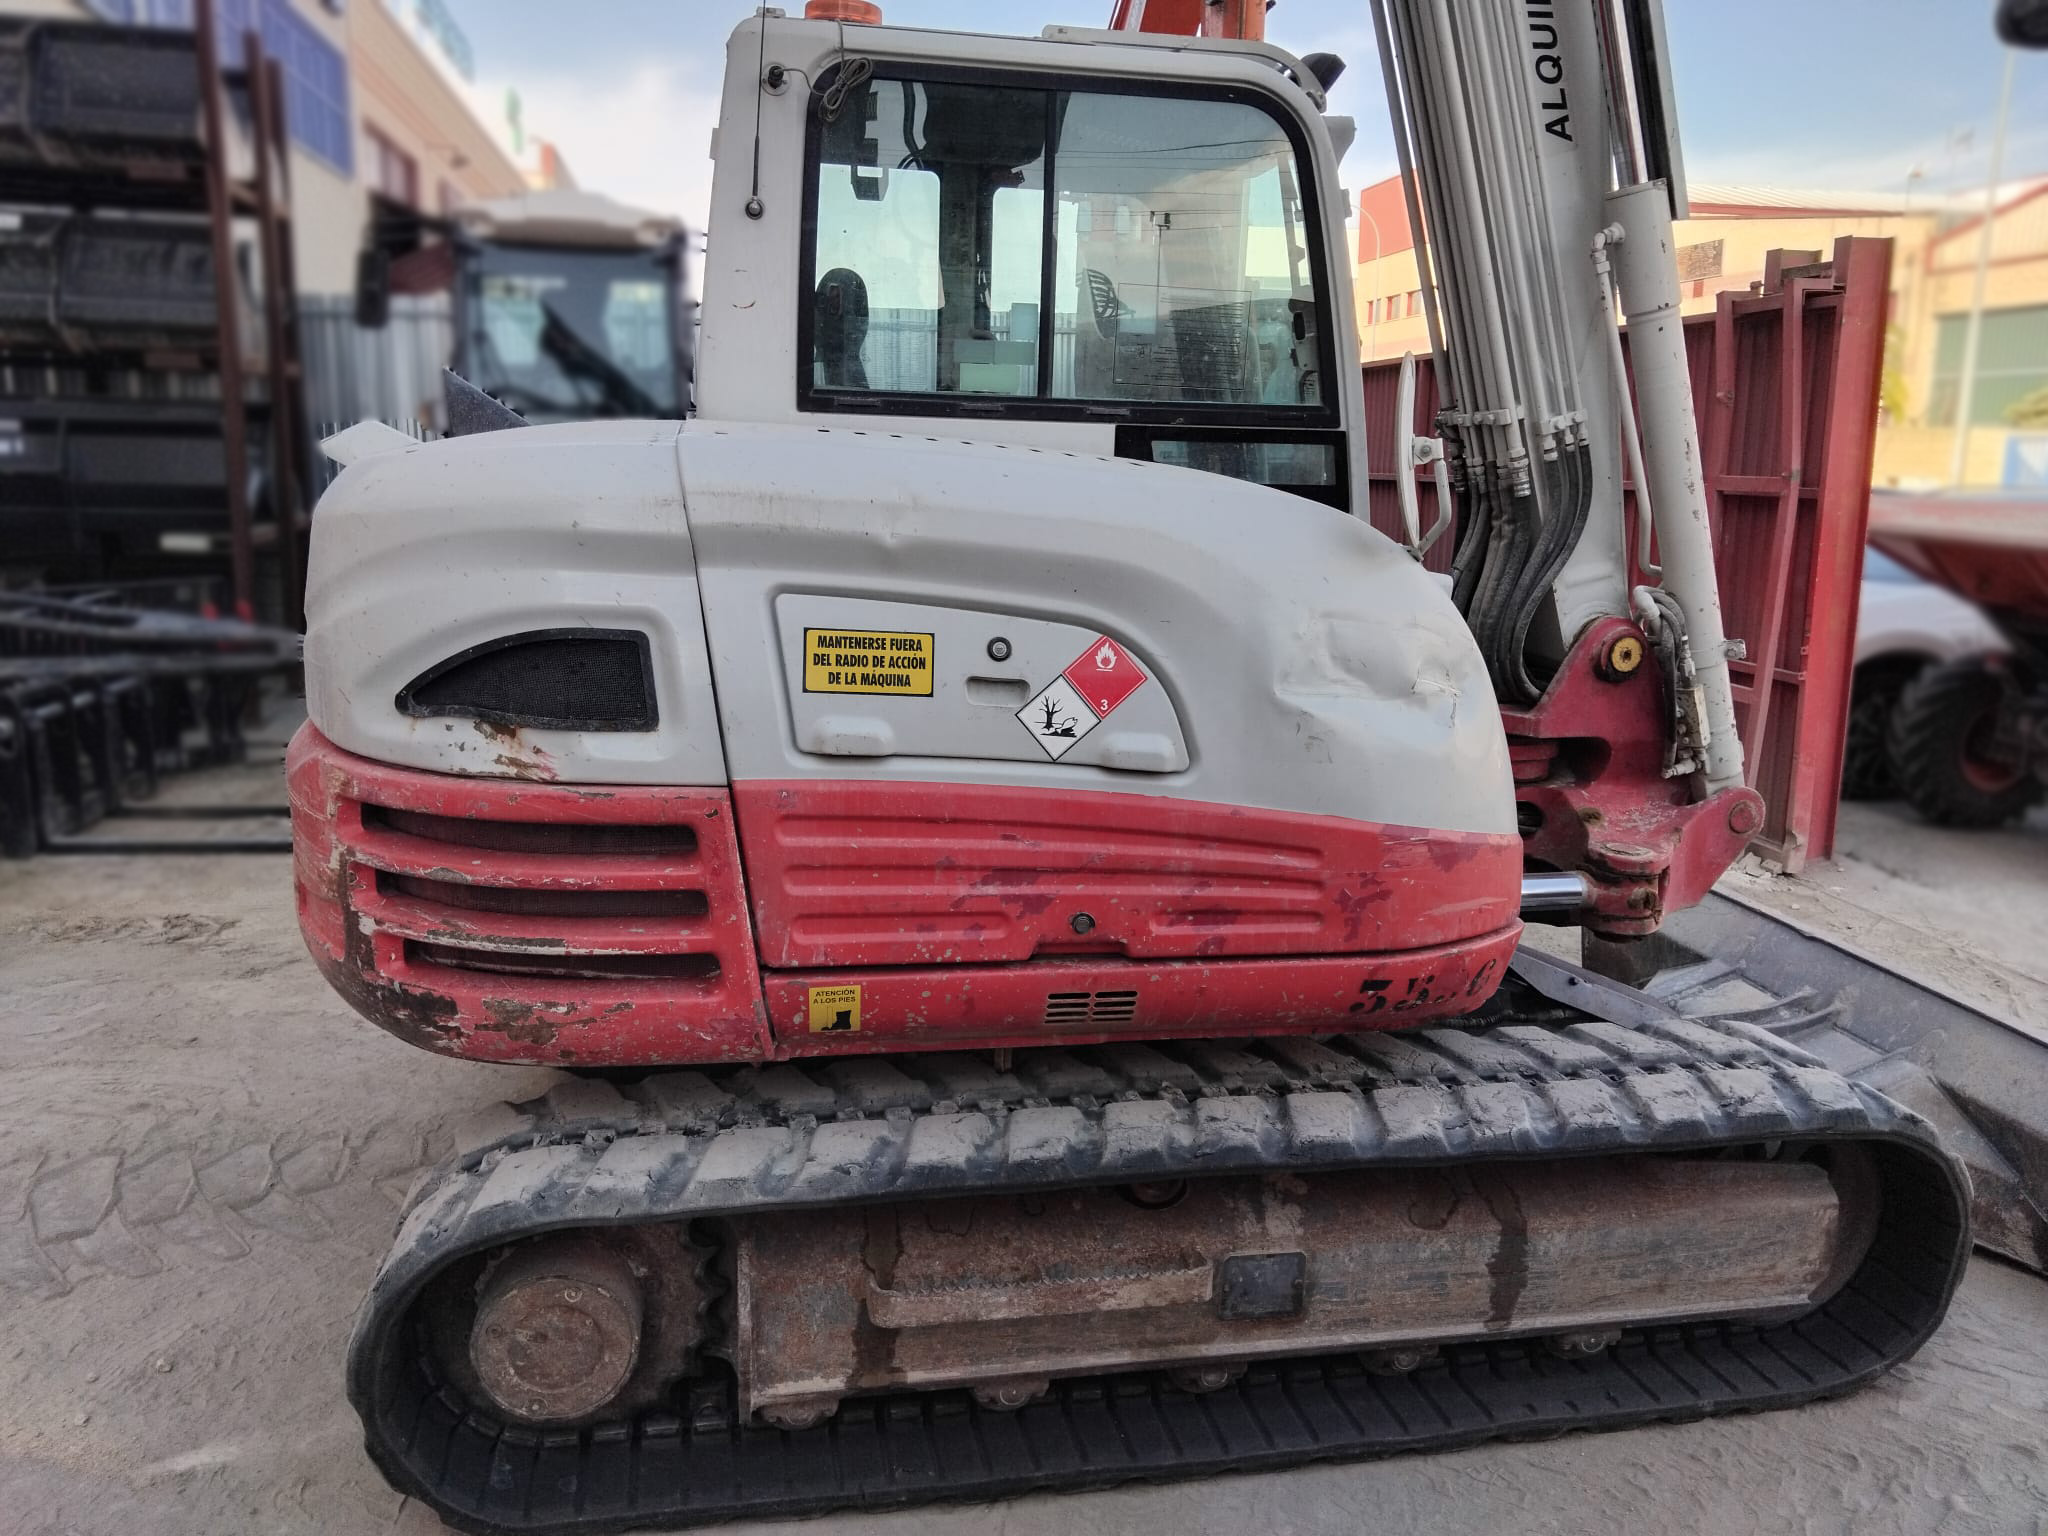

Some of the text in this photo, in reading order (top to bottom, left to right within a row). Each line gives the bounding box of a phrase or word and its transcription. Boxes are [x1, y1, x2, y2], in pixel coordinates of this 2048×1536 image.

[1525, 0, 1573, 142] ALQUI
[817, 635, 923, 652] MANTENERSE FUERA
[813, 653, 926, 670] DEL RADIO DE ACCIÓN
[828, 669, 912, 687] DE LA MÁQUINA
[1100, 699, 1109, 711] 3
[815, 988, 855, 997] ATENCIÓN
